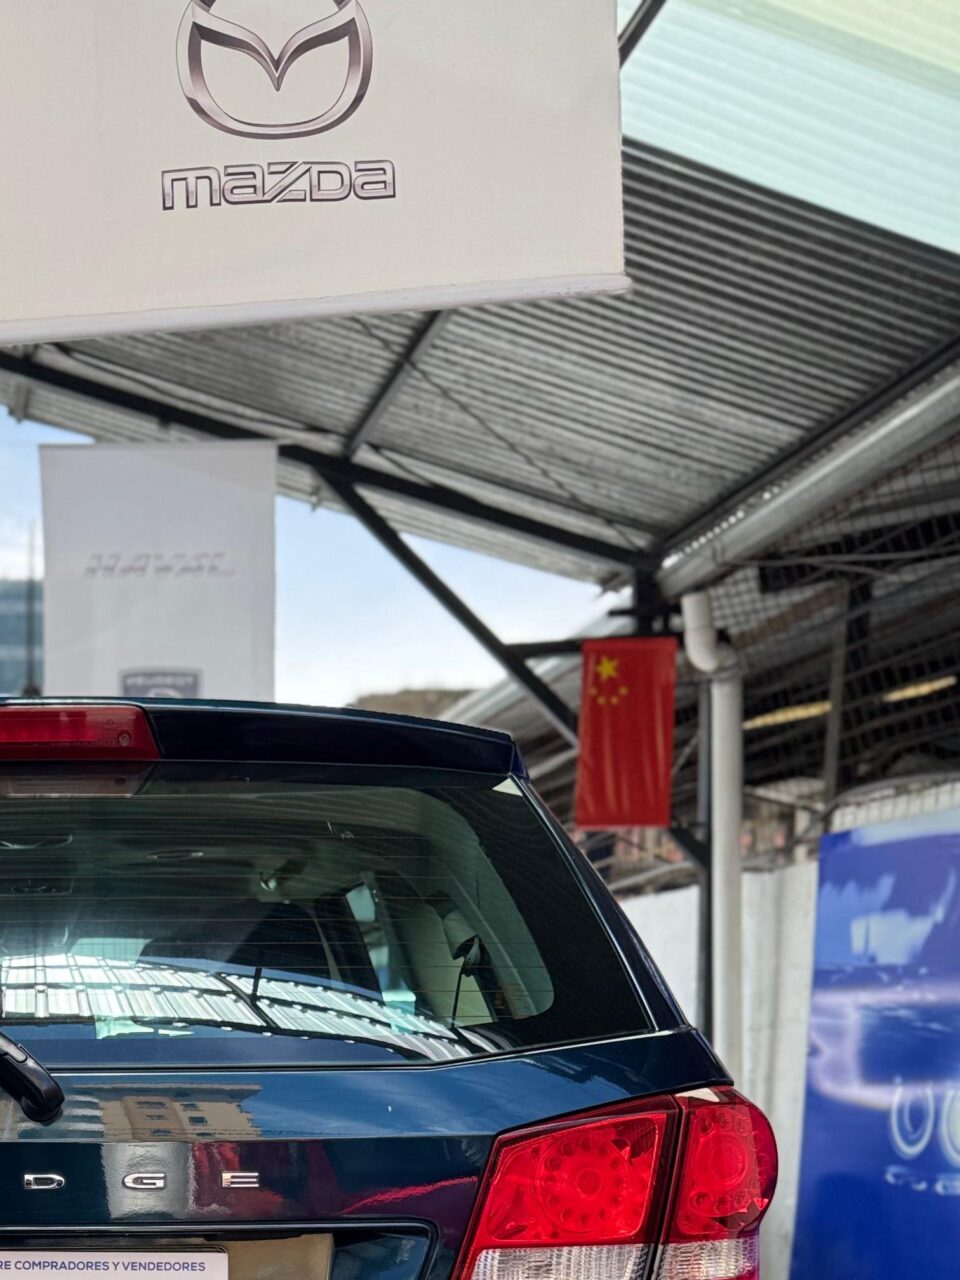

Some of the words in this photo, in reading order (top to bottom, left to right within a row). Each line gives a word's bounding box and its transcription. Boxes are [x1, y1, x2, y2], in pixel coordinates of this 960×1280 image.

[161, 159, 396, 211] mazda
[14, 1260, 110, 1272] COMPRADORES
[112, 1261, 121, 1271] Y
[122, 1261, 207, 1272] VENDEDORES
